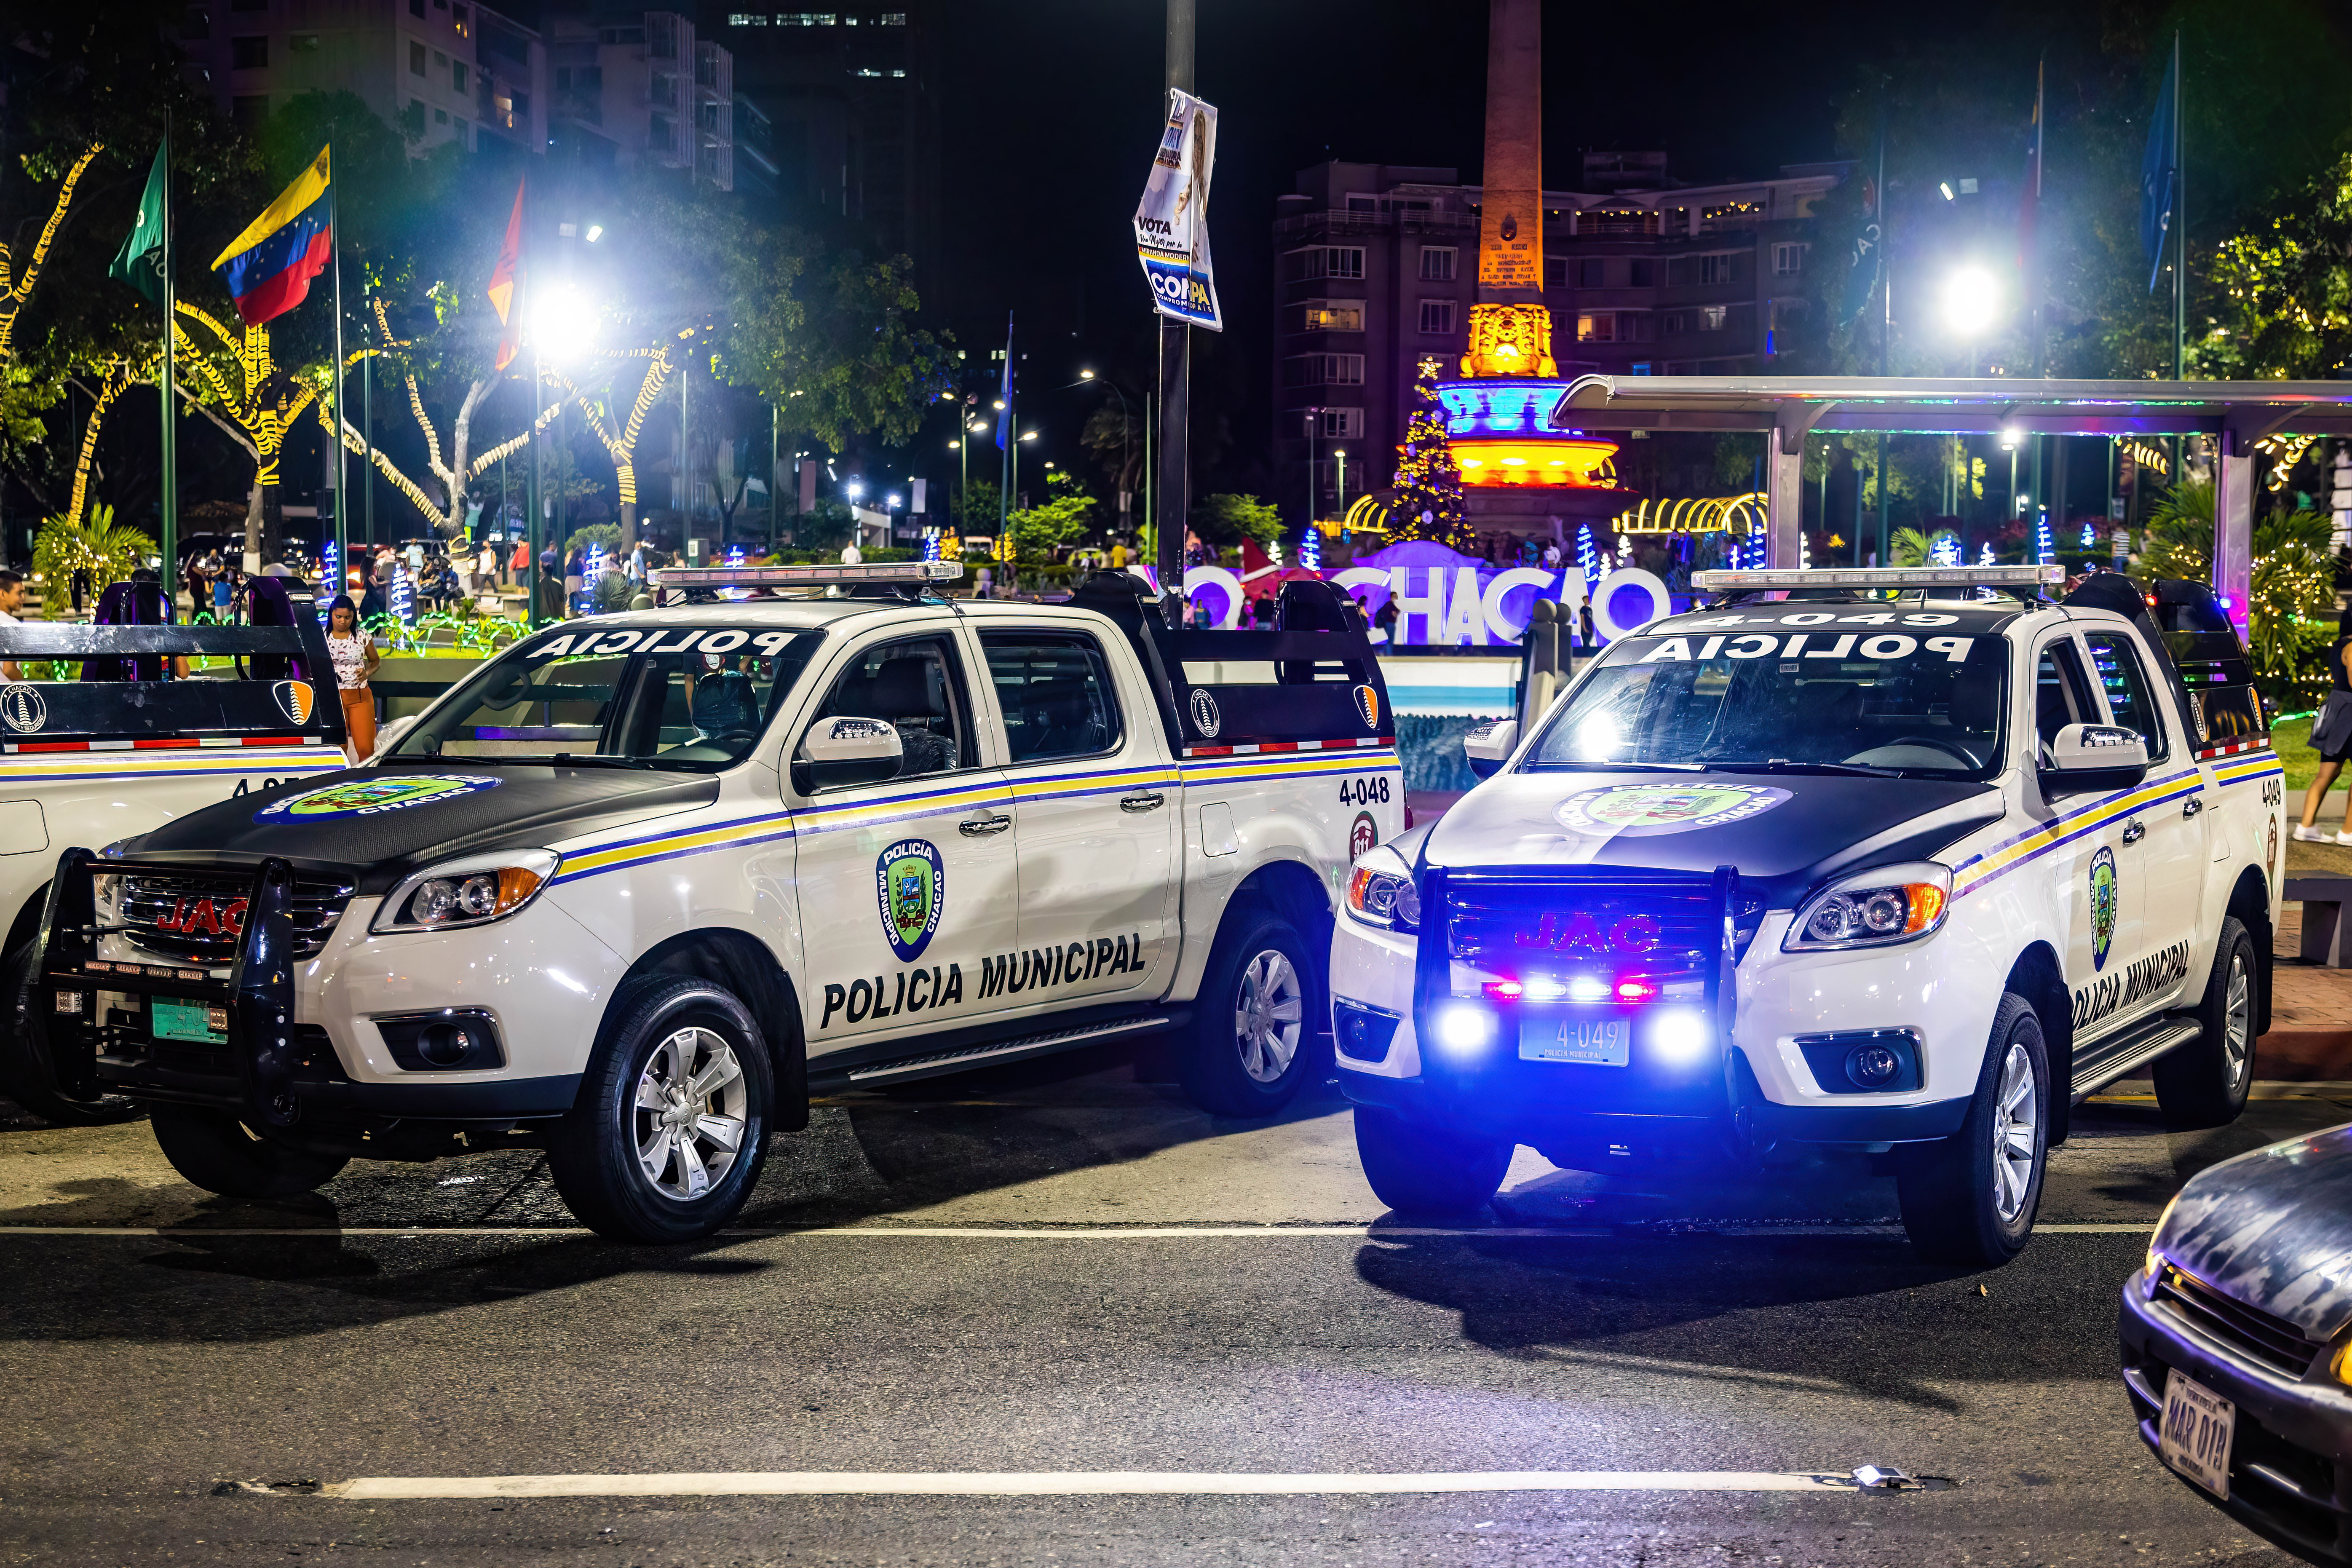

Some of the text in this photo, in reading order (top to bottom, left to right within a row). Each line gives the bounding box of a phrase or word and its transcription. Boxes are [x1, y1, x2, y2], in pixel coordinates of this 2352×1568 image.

[1138, 216, 1171, 235] VOTA
[1149, 234, 1165, 248] Mujer
[1166, 241, 1175, 249] por
[1687, 613, 1959, 627] 4-049
[8, 685, 32, 693] CHACAO
[357, 787, 476, 814] CHACAO
[1339, 776, 1390, 807] 4-048
[2263, 779, 2281, 808] 4-049
[1694, 796, 1777, 826] CHACAO
[883, 841, 932, 865] POLICÍA
[1354, 838, 1369, 858] 911
[157, 897, 248, 935] JAC
[879, 870, 899, 946] MUNICIPIO
[927, 870, 942, 933] CHACAO
[1515, 911, 1661, 954] JAC
[820, 933, 1146, 1029] POLICIA MUNICIPAL
[2072, 939, 2189, 1030] OLICIA MUNICIPAL
[1556, 1019, 1619, 1050] 4-049
[1544, 1049, 1600, 1059] POLICIA MUNICIPAL
